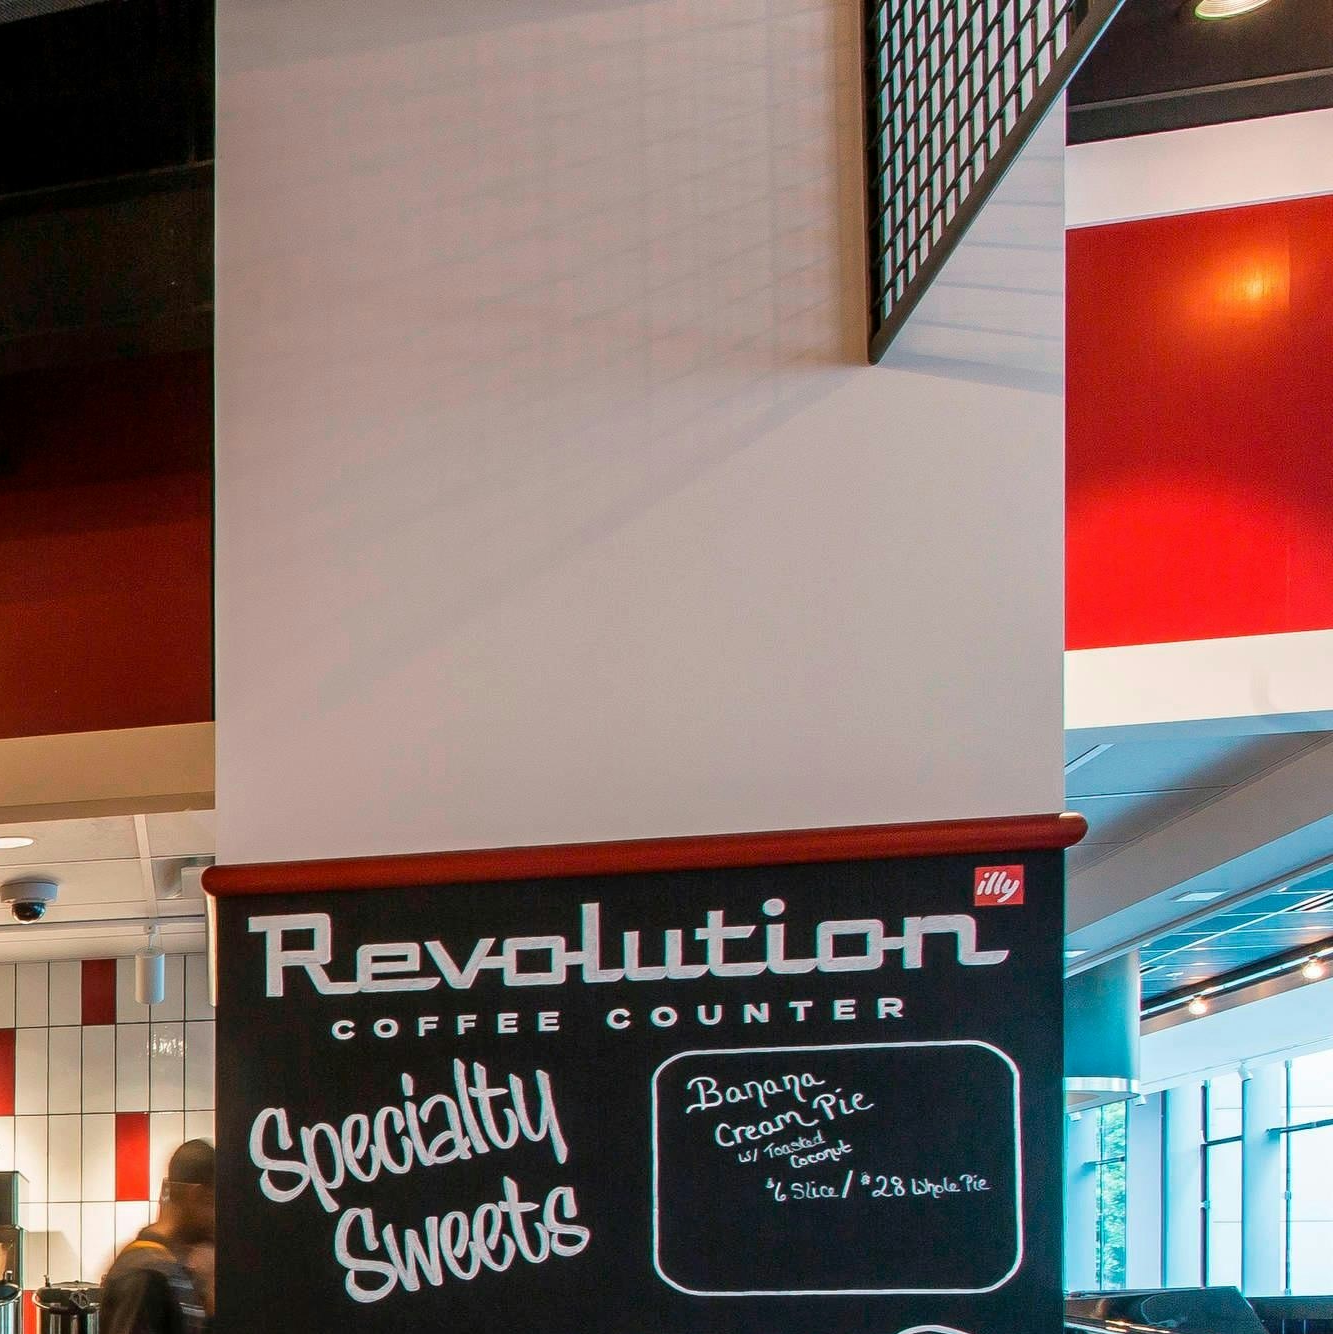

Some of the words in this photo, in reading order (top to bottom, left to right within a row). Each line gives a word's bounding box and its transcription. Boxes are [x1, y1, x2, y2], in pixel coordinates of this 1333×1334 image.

[977, 871, 1020, 903] illy
[248, 898, 1010, 997] Revolution
[331, 1010, 562, 1041] COFFEE
[606, 997, 907, 1030] COUNTER
[685, 1072, 826, 1113] Banana
[249, 1058, 569, 1213] Specialty
[715, 1110, 819, 1147] Cream
[813, 1088, 874, 1120] Pie
[764, 1130, 826, 1158] Toasted
[790, 1139, 853, 1168] Coconut
[766, 1178, 787, 1201] $6
[861, 1171, 905, 1197] $28
[911, 1177, 960, 1198] Whole
[960, 1174, 991, 1191] Pie
[333, 1177, 591, 1304] Sweets
